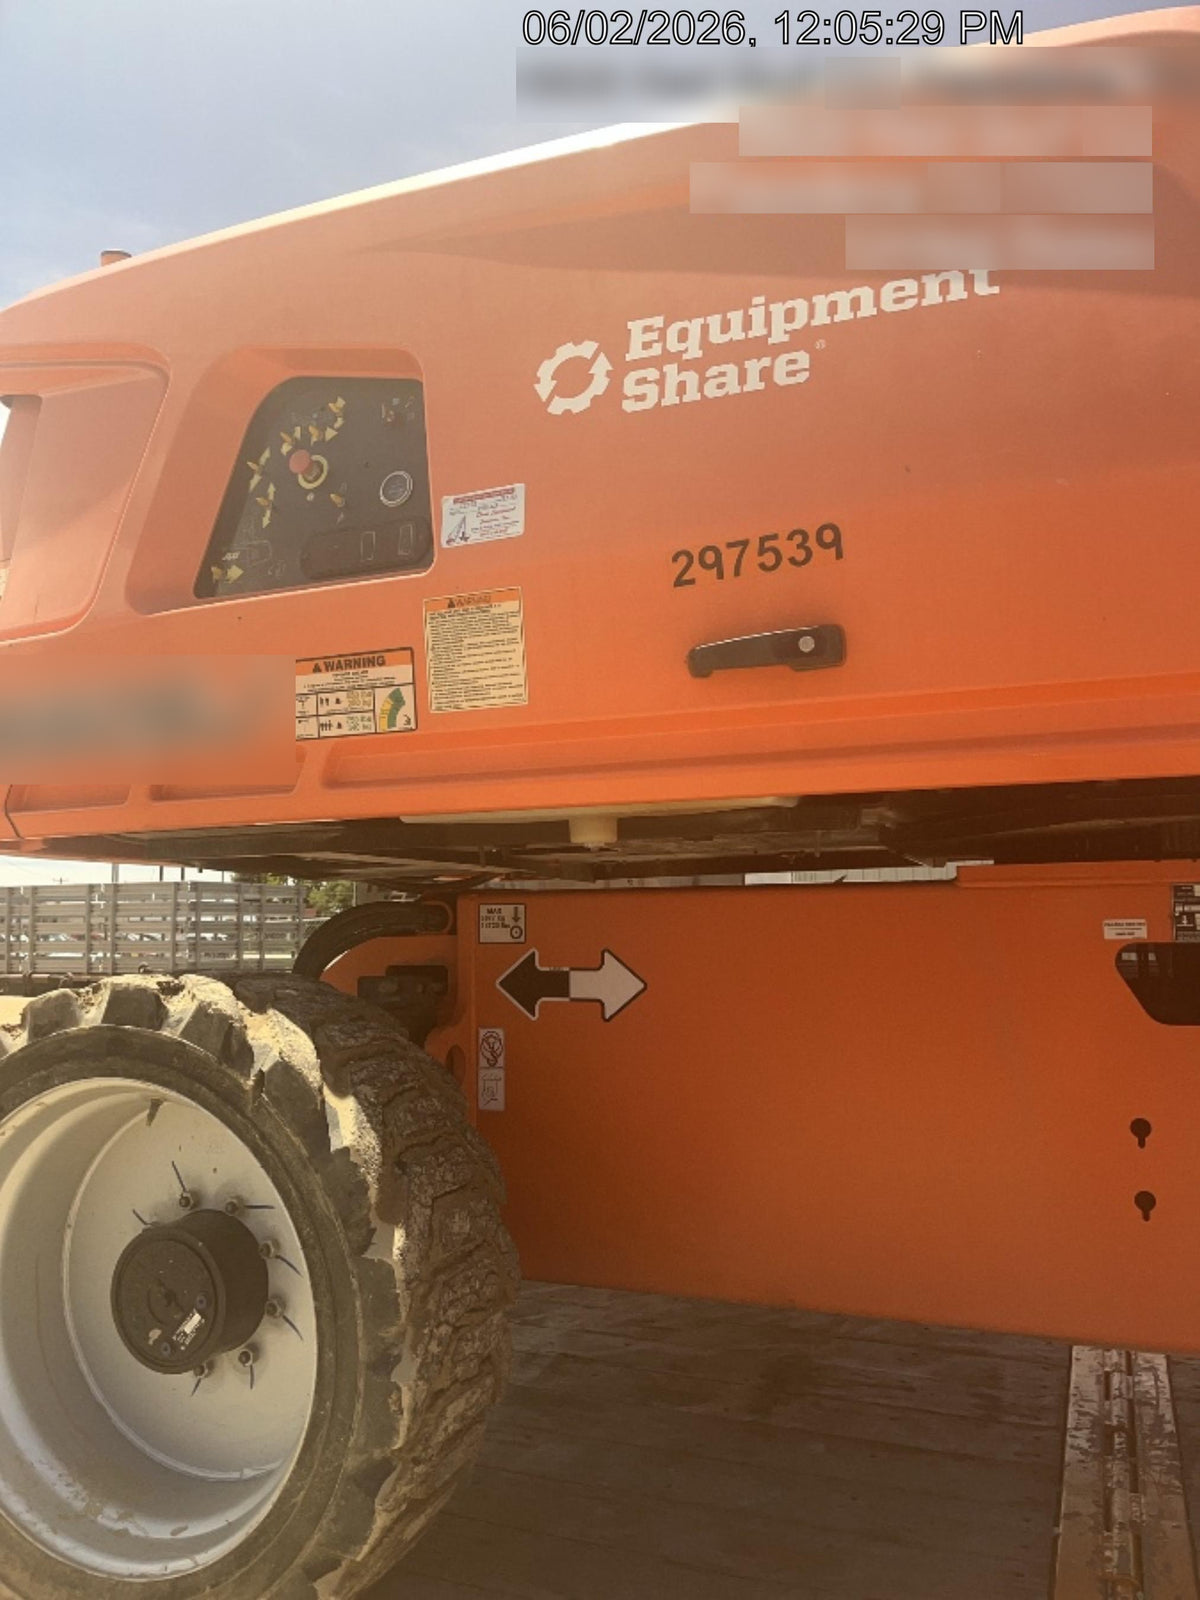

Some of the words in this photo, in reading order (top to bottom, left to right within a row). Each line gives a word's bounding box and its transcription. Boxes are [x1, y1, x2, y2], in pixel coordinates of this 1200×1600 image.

[625, 269, 1000, 361] Equipment
[621, 349, 811, 413] Share
[671, 522, 844, 588] 297539
[323, 655, 386, 672] WARNING
